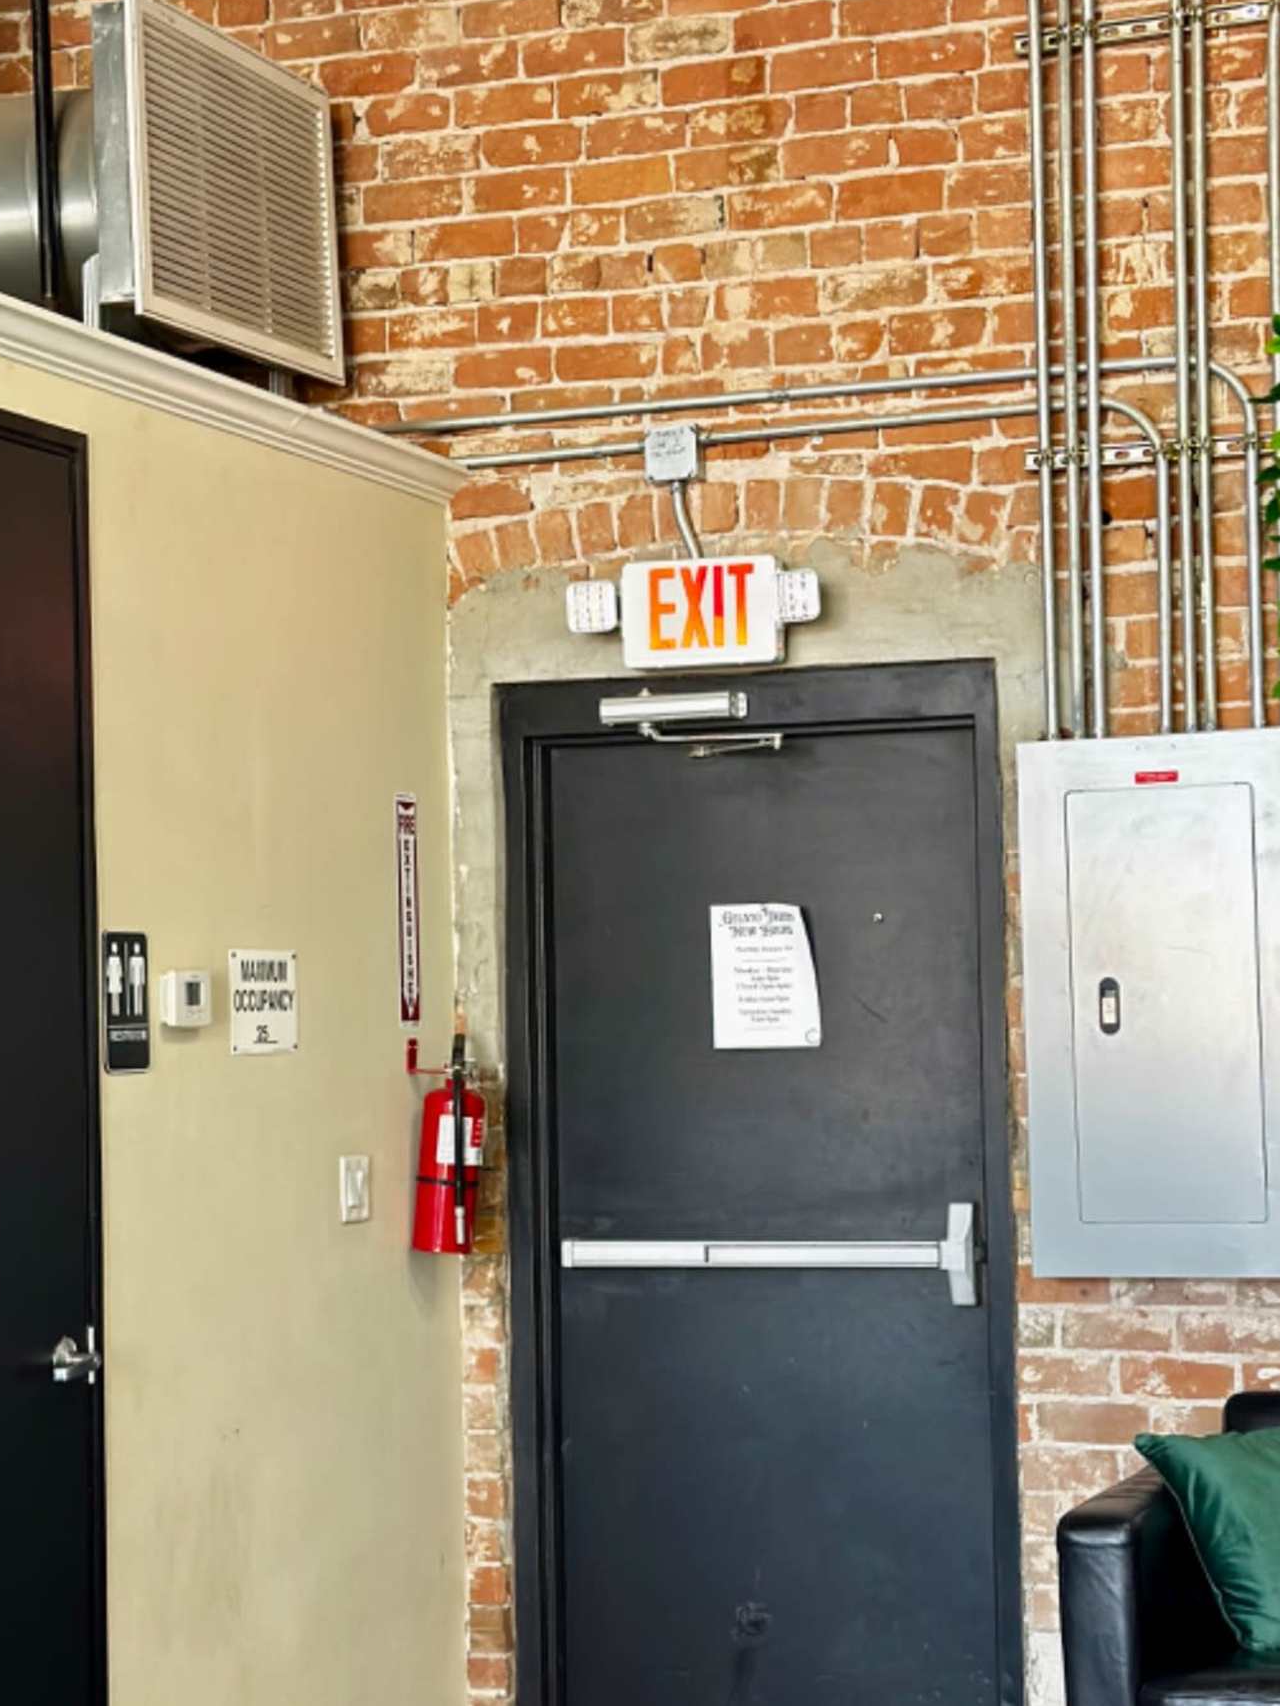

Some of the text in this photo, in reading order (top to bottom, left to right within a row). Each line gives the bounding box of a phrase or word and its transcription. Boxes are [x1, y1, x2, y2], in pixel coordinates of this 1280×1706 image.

[648, 563, 755, 651] EXIT
[240, 959, 288, 983] MAXIMUM
[233, 989, 296, 1013] OCCUPANCY
